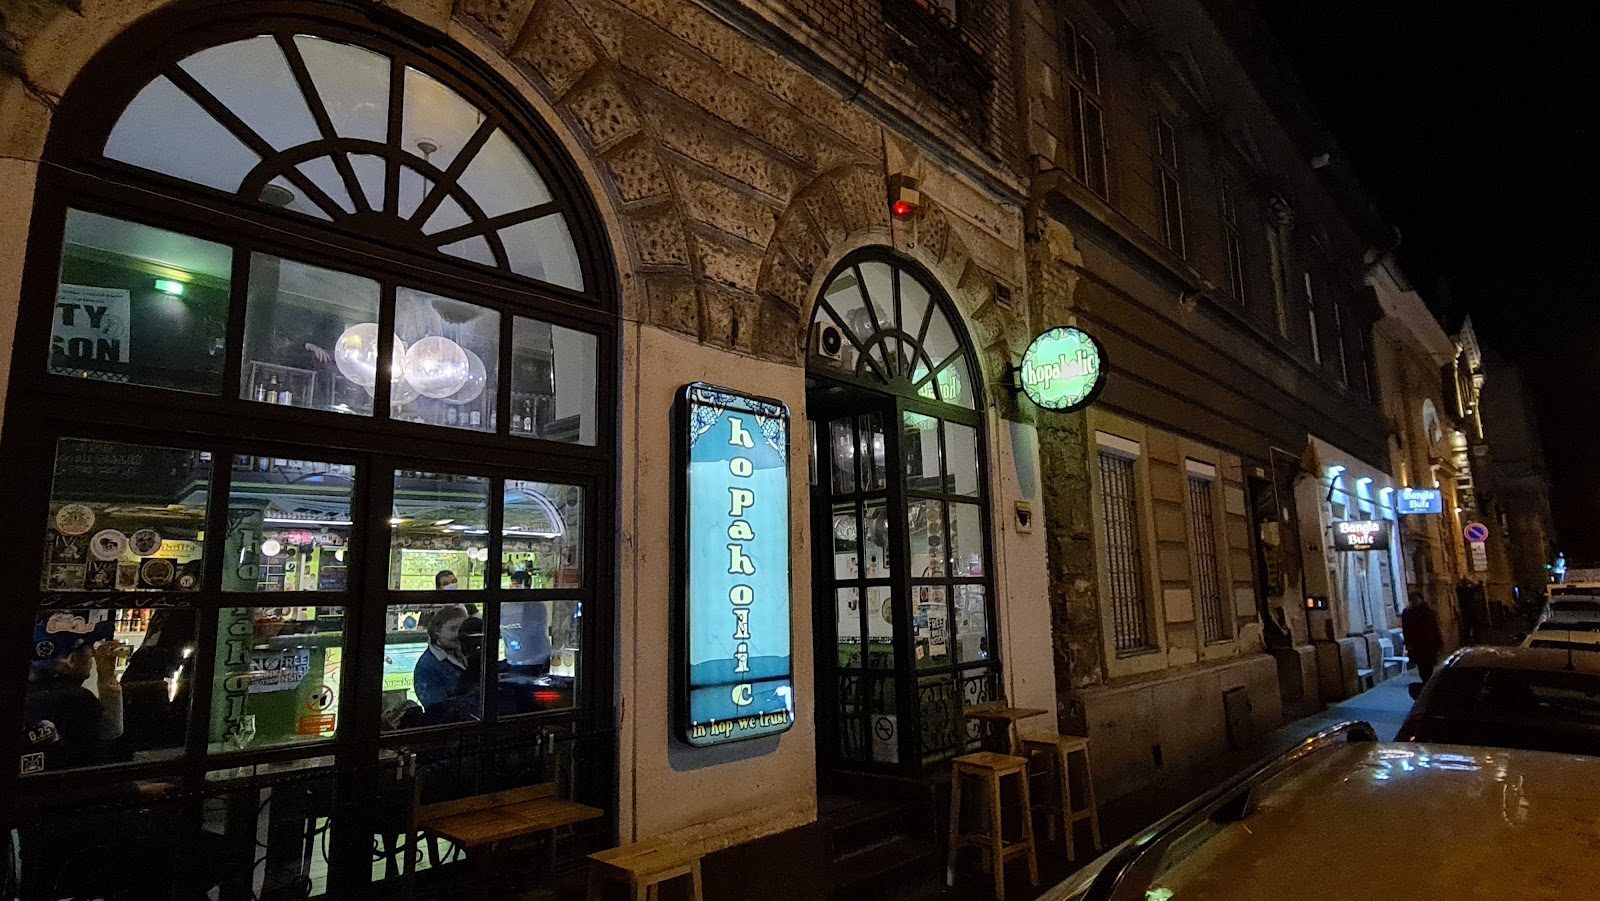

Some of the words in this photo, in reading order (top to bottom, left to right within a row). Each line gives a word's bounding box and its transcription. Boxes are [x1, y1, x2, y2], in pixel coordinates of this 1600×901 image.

[56, 303, 108, 328] TY
[1339, 520, 1380, 534] Bangla
[727, 416, 756, 708] hopaholic
[692, 720, 706, 738] in
[709, 718, 733, 738] hop
[736, 717, 757, 730] we
[758, 709, 788, 727] trust
